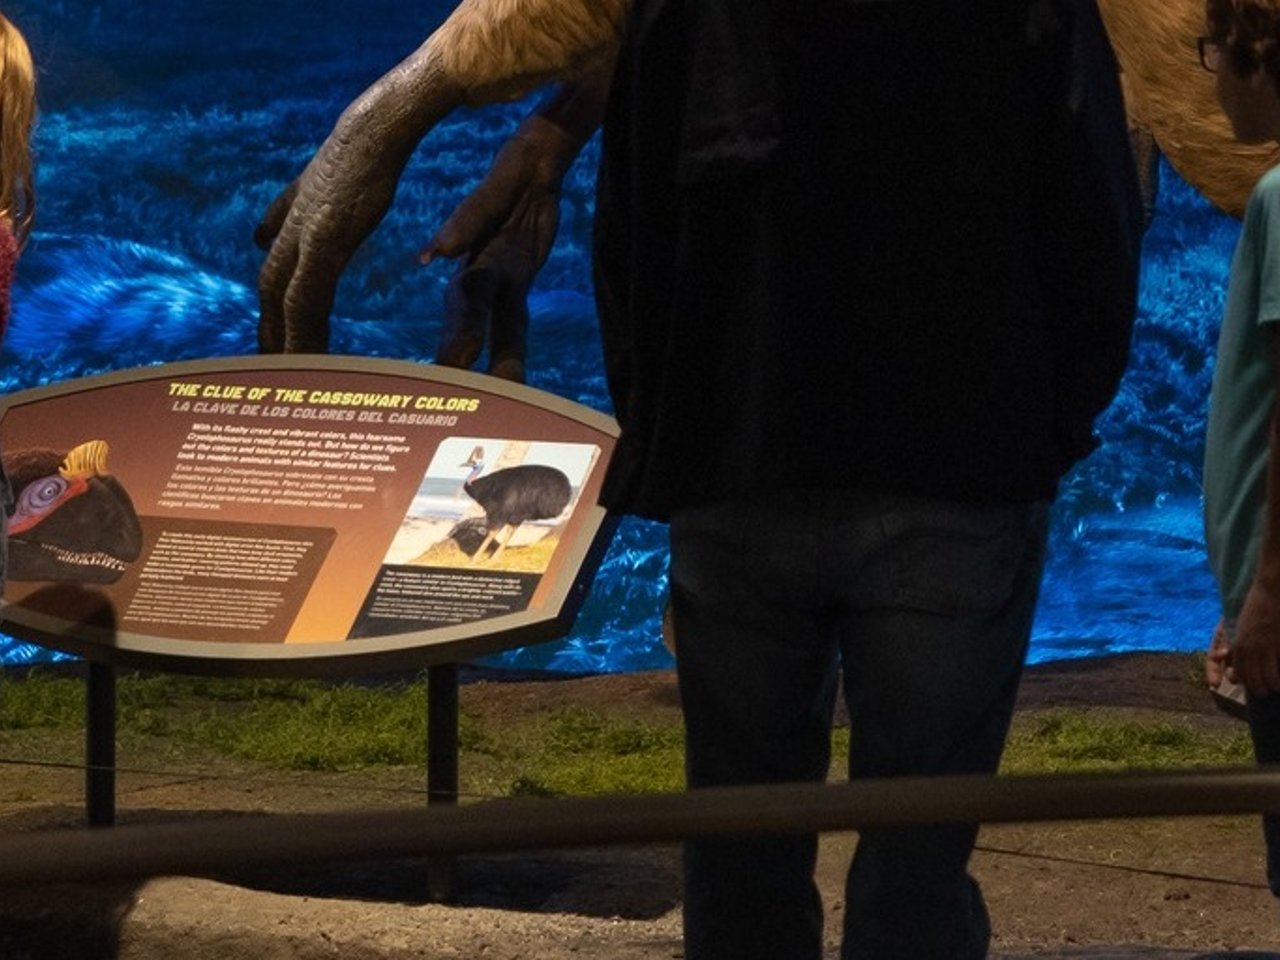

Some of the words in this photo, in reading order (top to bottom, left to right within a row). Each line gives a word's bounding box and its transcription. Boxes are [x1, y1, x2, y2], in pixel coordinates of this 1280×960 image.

[170, 383, 199, 397] THE
[203, 385, 244, 399] CLUE
[248, 387, 270, 400] OF
[275, 388, 306, 402] THE
[309, 390, 412, 408] CASSOWARY
[415, 396, 480, 411] COLORS
[172, 401, 191, 412] LA
[193, 402, 238, 415] CLAVE
[240, 404, 260, 416] DE
[262, 406, 290, 417] LOS
[292, 407, 356, 421] COLORES
[358, 411, 384, 422] DEL
[388, 412, 459, 426] CASUARIO
